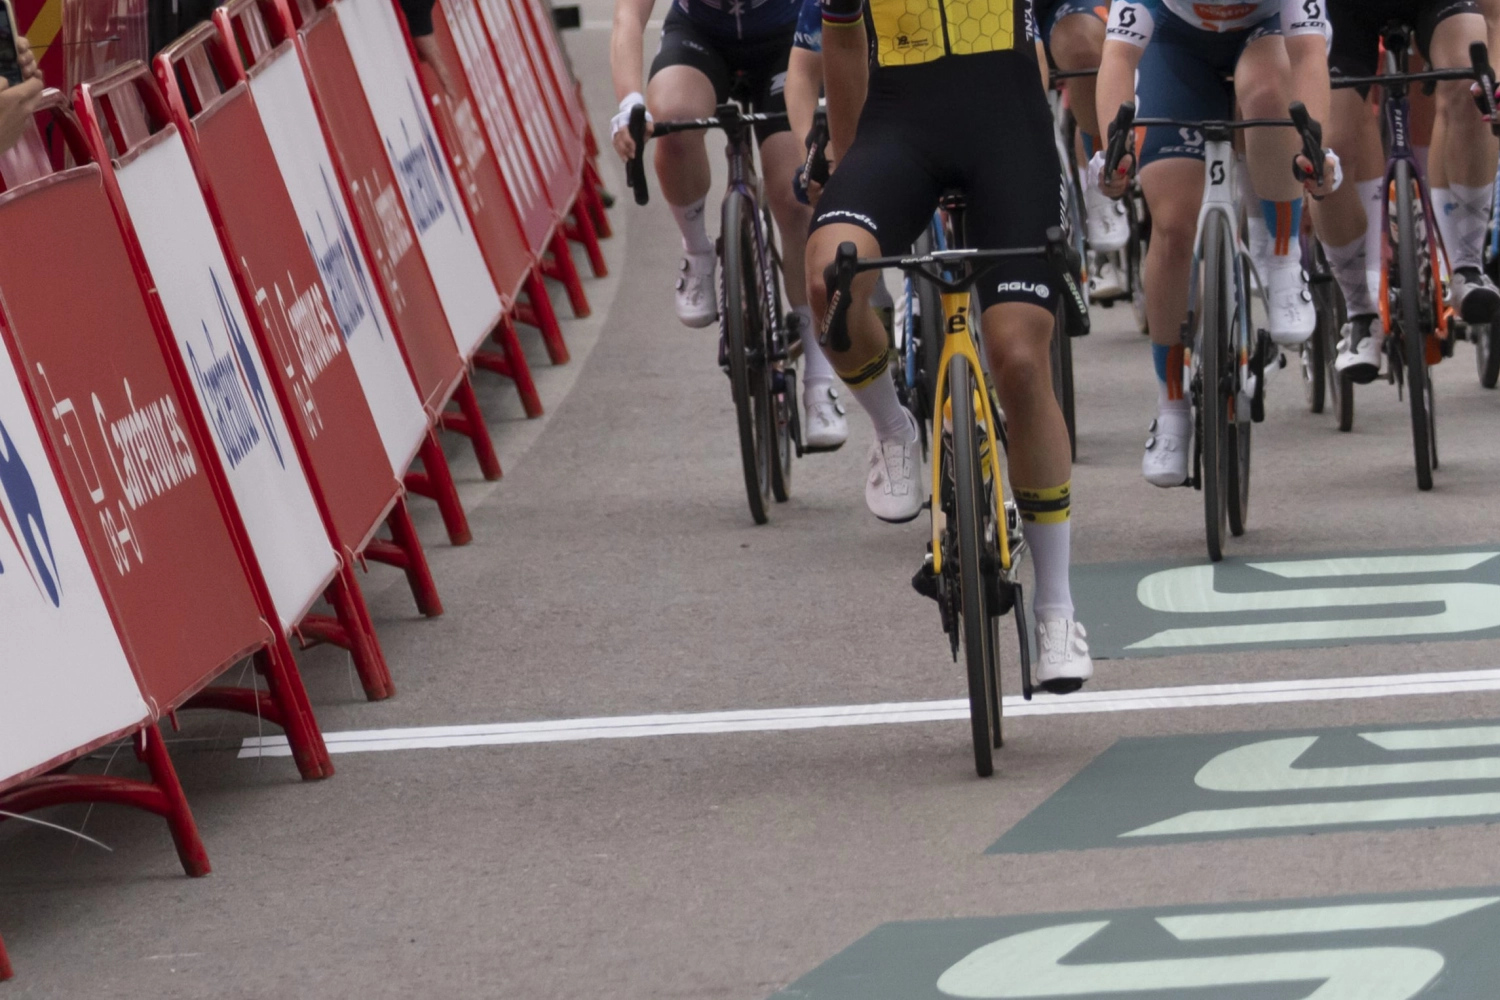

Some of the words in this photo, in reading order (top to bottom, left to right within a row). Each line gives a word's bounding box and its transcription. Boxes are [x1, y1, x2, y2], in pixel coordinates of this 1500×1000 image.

[1106, 26, 1148, 41] SCOTT
[1394, 108, 1404, 147] FACTOR
[816, 209, 878, 231] cervélo
[901, 255, 934, 264] cervélo
[997, 281, 1035, 293] AGU
[1063, 272, 1087, 314] SRAM
[186, 319, 260, 470] Carrefour
[91, 377, 197, 510] Carrefour.es
